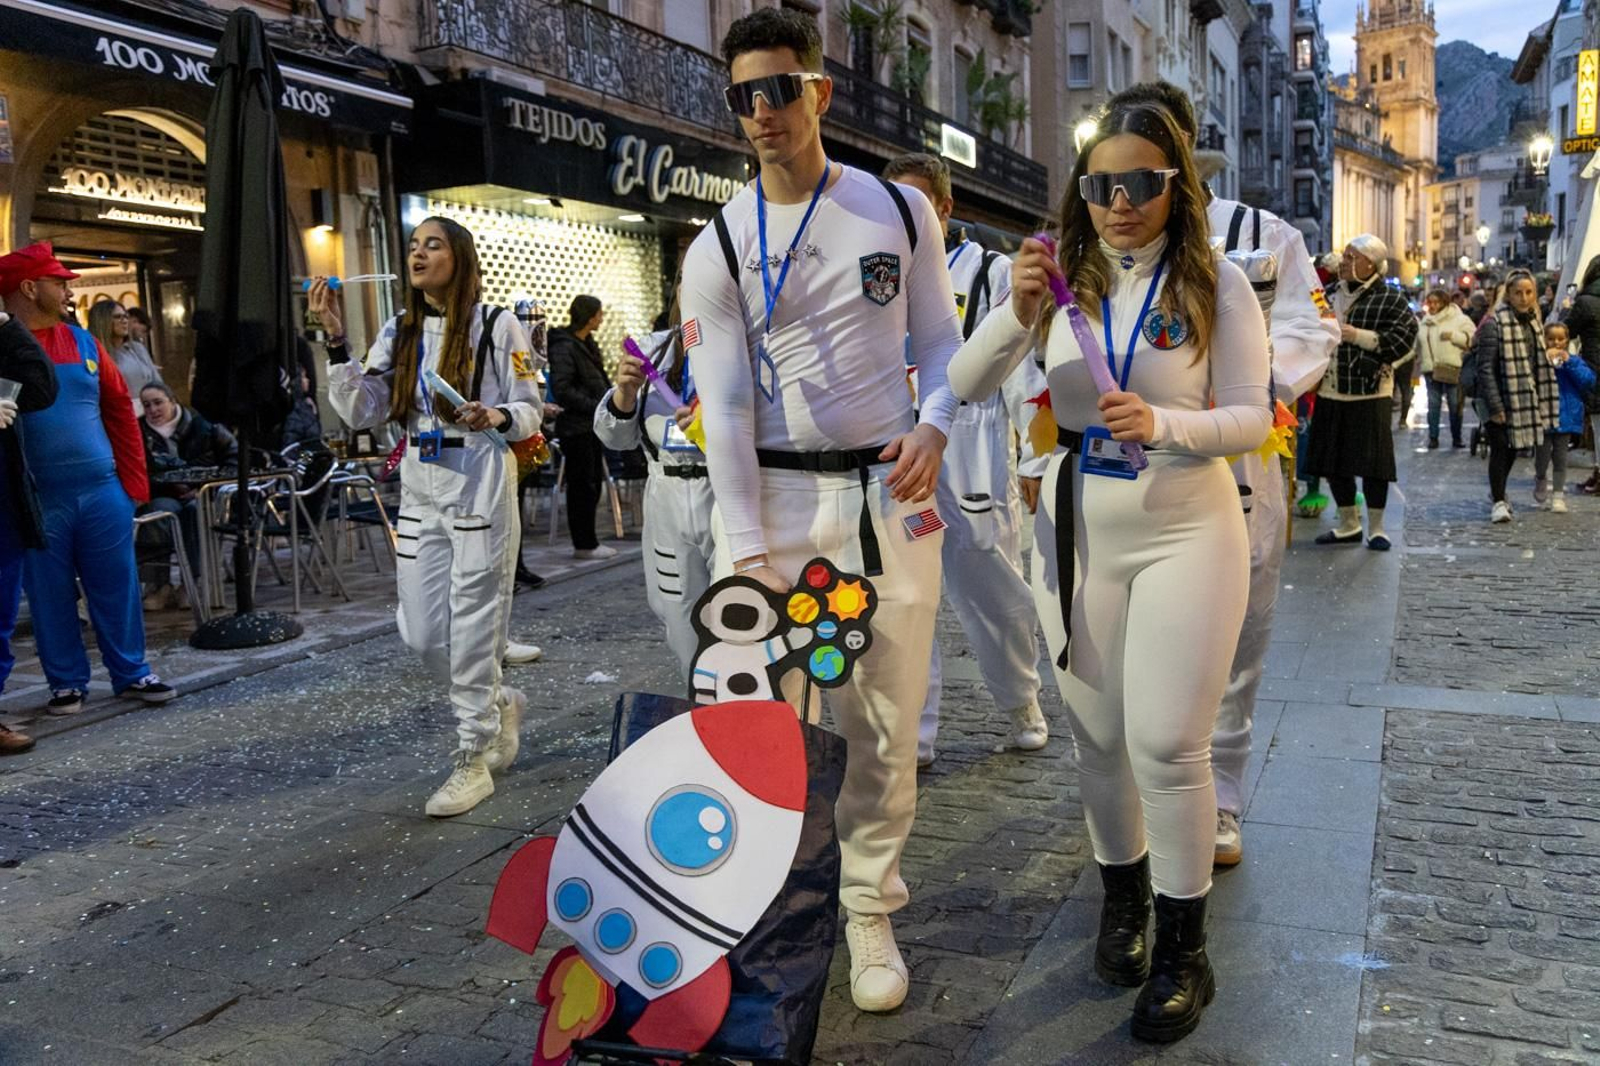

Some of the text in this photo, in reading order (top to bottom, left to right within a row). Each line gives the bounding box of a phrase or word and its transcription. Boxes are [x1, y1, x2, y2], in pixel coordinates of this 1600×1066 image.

[95, 36, 165, 75] 100
[1580, 54, 1595, 131] AMATE
[503, 96, 607, 150] TEJIDOS
[61, 166, 111, 196] 100
[609, 134, 648, 196] El
